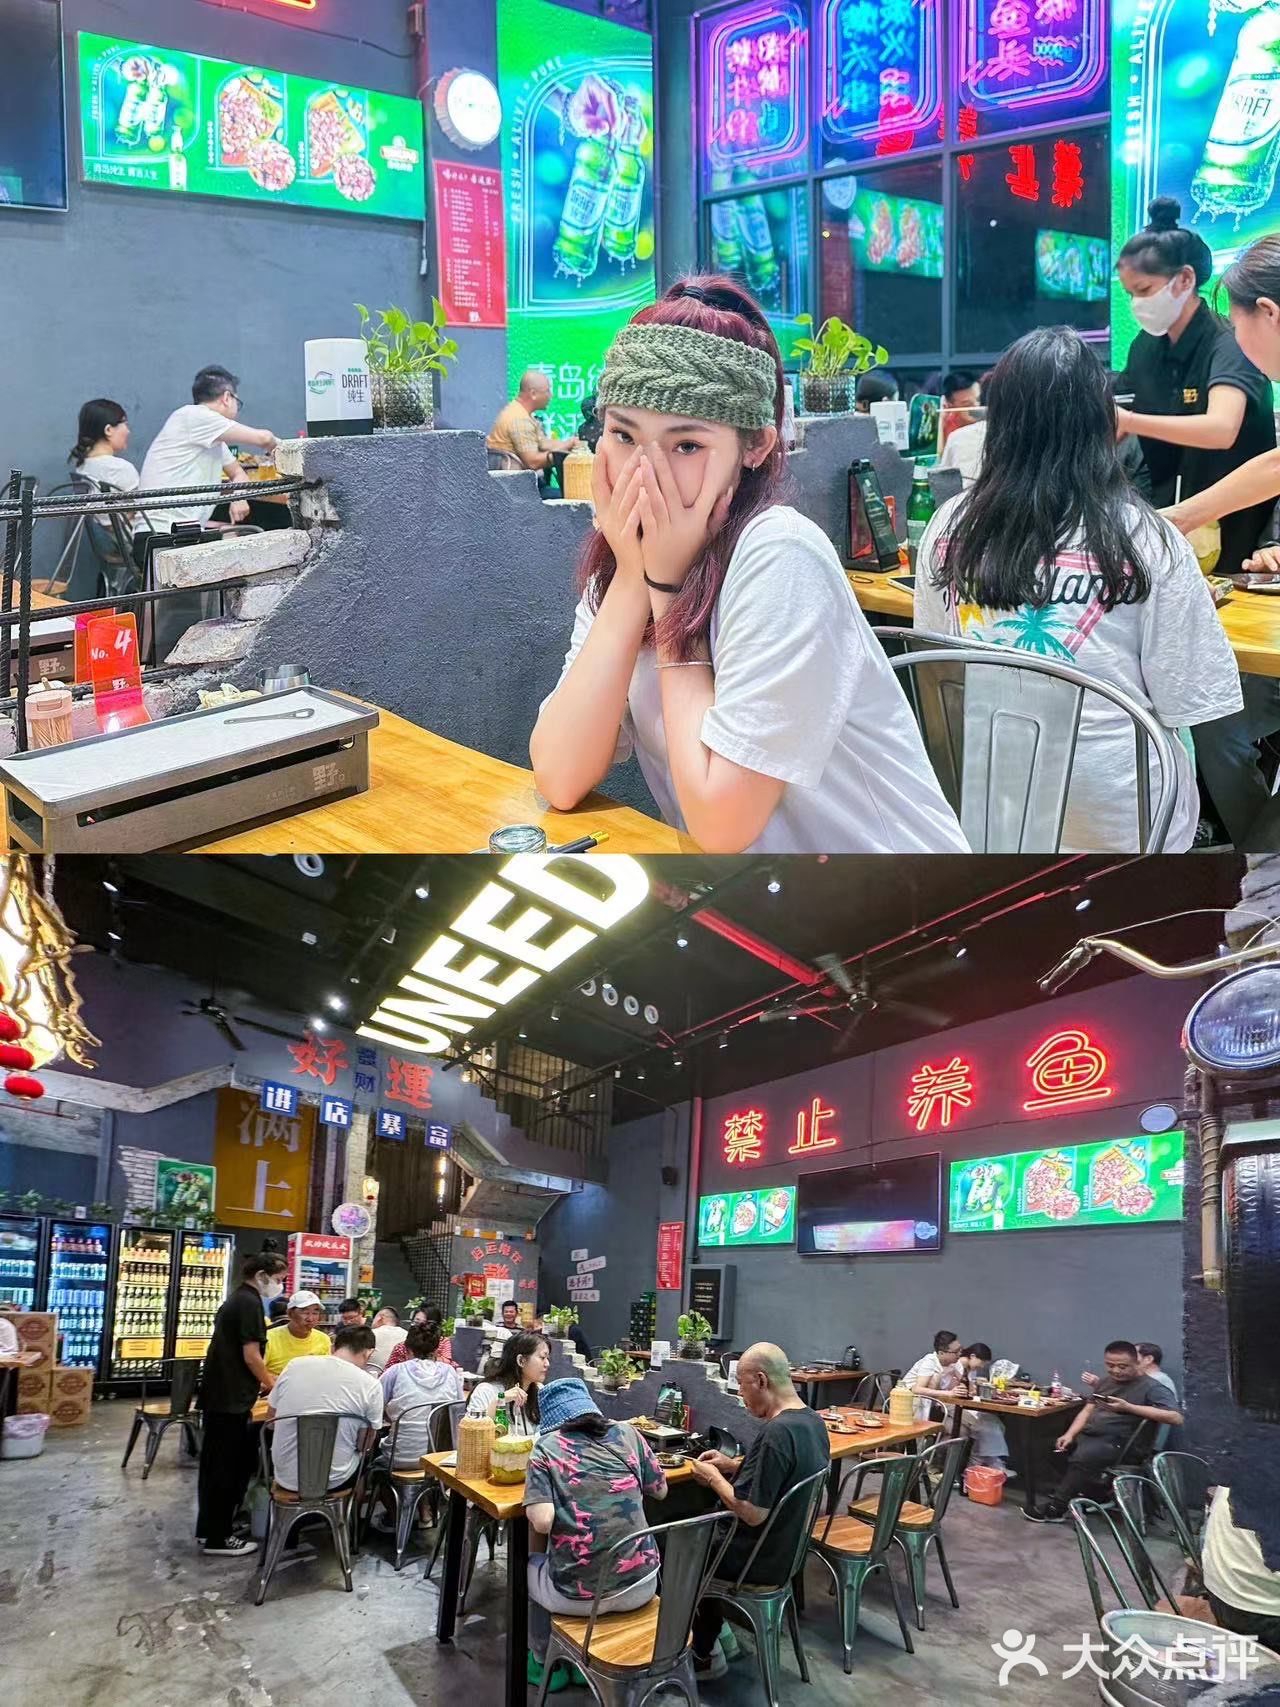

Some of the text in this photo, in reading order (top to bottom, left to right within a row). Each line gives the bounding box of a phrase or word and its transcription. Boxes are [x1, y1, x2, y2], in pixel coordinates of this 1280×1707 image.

[531, 56, 564, 82] PURE
[511, 94, 527, 146] ALIVE
[341, 374, 369, 389] DRAFT
[347, 389, 367, 403] 纯生
[91, 629, 132, 660] No. 4
